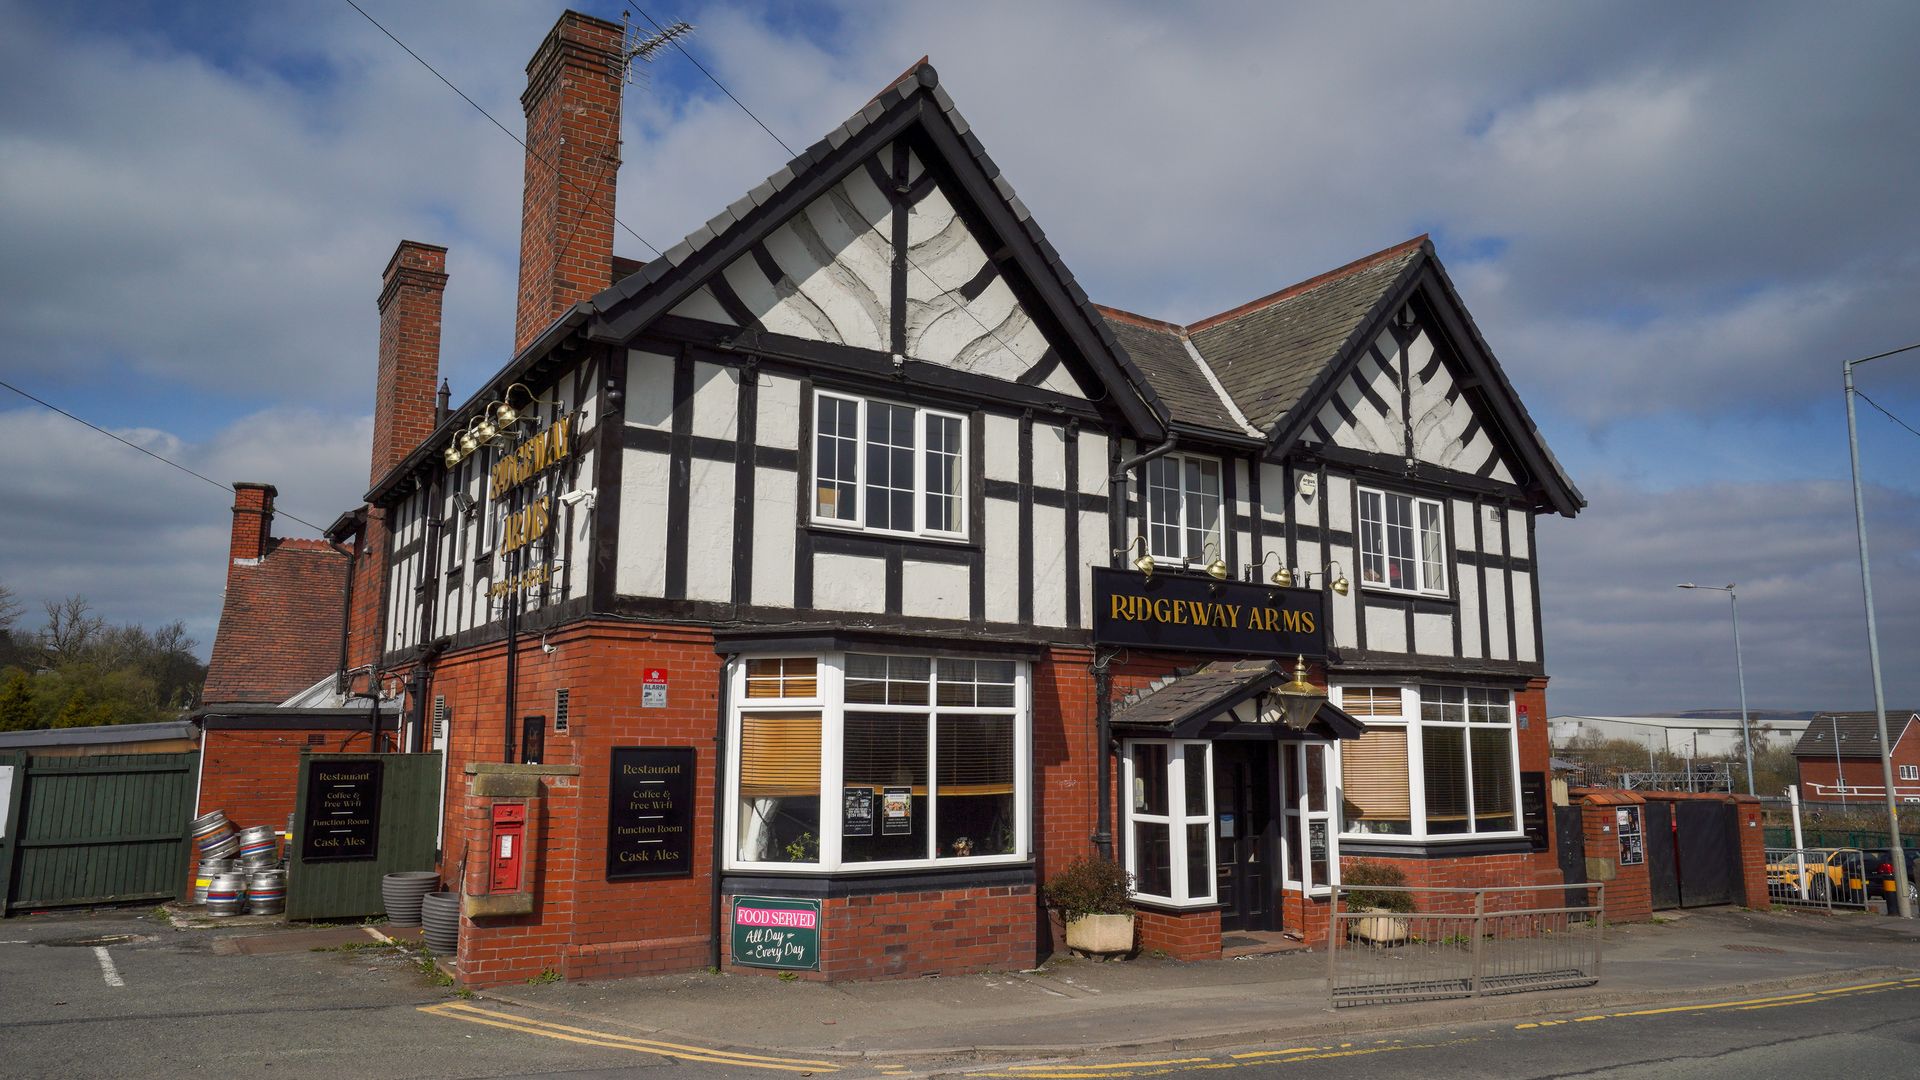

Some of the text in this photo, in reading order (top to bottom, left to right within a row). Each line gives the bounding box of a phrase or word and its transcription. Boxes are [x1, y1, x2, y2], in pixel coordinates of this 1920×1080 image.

[490, 413, 572, 500] RIDGEWAY
[501, 496, 550, 557] ARMS
[1111, 594, 1315, 634] RIDGEWAY ARMS
[623, 764, 681, 775] Restaurant
[319, 772, 370, 781] Restaurant
[353, 792, 360, 800] &
[633, 790, 671, 800] Coffee &
[630, 801, 673, 810] Free Wi-fi
[618, 825, 683, 834] Function Room
[314, 837, 366, 847] Cask Ales
[620, 849, 679, 862] Cask Ales
[738, 909, 815, 926] FOOD SERVED
[745, 928, 784, 947] All Day
[756, 942, 805, 962] Every Day
